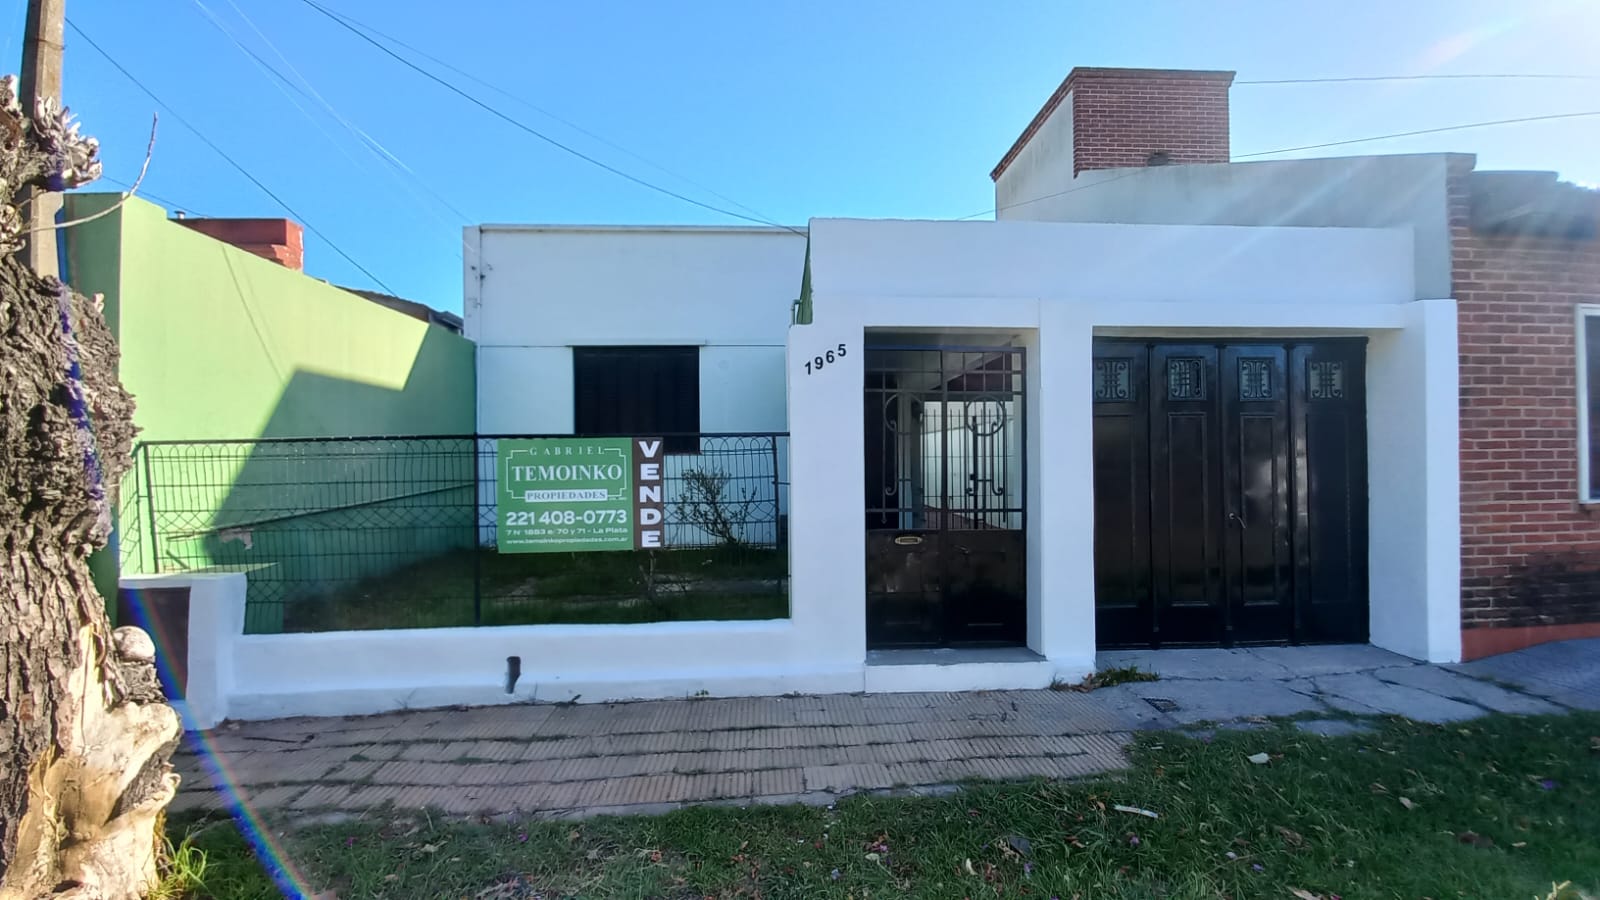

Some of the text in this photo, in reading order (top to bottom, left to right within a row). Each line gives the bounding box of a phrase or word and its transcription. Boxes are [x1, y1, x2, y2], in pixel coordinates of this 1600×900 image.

[804, 343, 847, 376] 1965
[529, 446, 605, 456] GABRIEL
[511, 464, 623, 482] TEMOINKO
[527, 490, 606, 500] PROPIEDADES
[638, 440, 662, 548] VENDE
[505, 509, 628, 526] 221 408-0773
